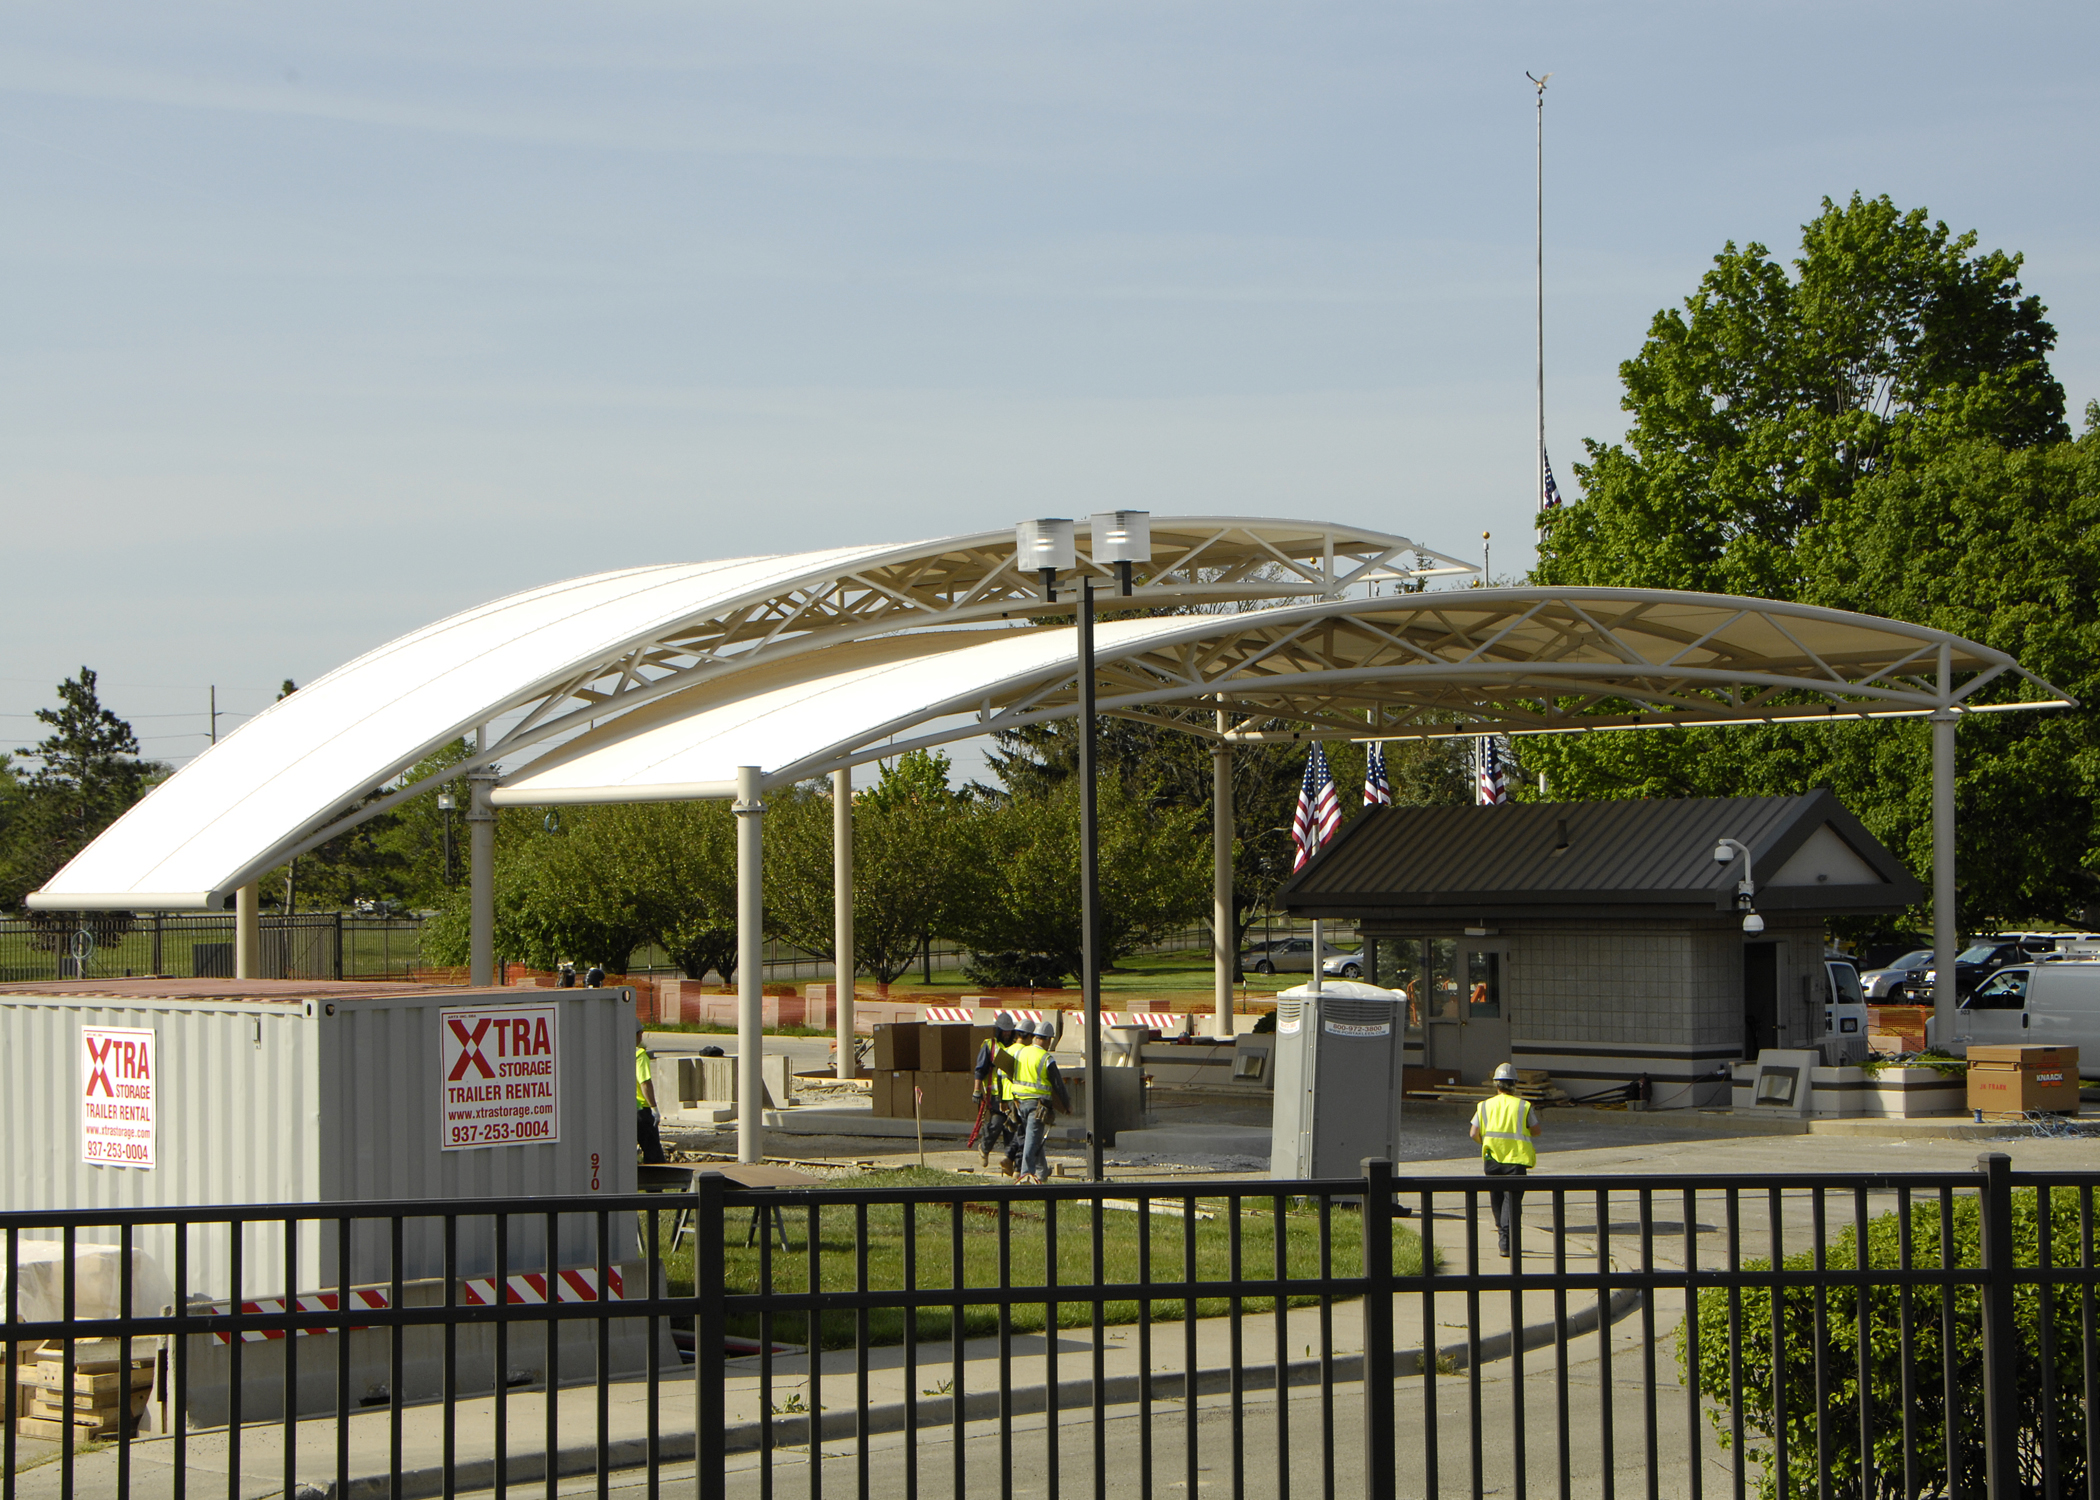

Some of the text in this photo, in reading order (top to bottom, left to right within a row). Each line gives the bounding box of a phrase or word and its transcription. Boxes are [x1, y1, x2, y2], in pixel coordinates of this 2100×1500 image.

[1333, 1023, 1382, 1032] 800-972-3800
[447, 1017, 552, 1081] XTRA
[86, 1037, 150, 1097] XTRA
[499, 1060, 552, 1078] STORAGE
[2036, 1073, 2063, 1082] KNAACK
[115, 1083, 151, 1099] STORAGE
[448, 1081, 552, 1103] TRAILER RENTAL
[86, 1102, 150, 1121] TRAILER RENTAL
[448, 1104, 553, 1121] www.xtrastorage.com
[86, 1125, 150, 1139] www.xtrastorage.com
[452, 1120, 550, 1143] 937-253-0004
[87, 1140, 149, 1160] 937-253-0004
[591, 1153, 600, 1191] 970
